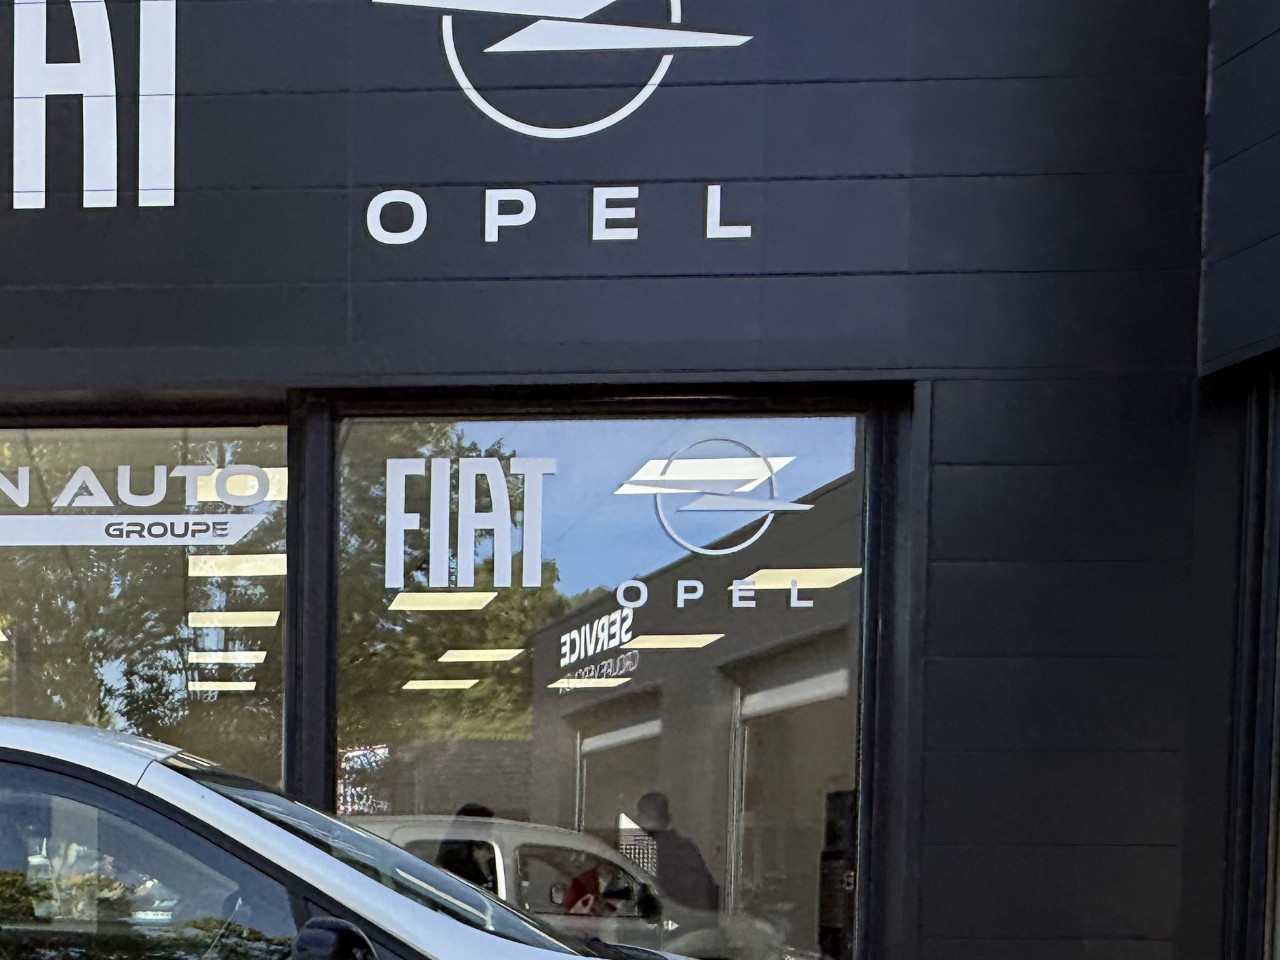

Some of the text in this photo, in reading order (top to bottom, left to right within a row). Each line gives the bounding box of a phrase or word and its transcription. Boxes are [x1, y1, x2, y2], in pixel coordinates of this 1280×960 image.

[366, 185, 752, 245] OPEL
[53, 464, 269, 507] AUTO
[104, 522, 229, 539] GROUPE
[385, 457, 557, 588] FIAT
[616, 579, 814, 608] OPEL
